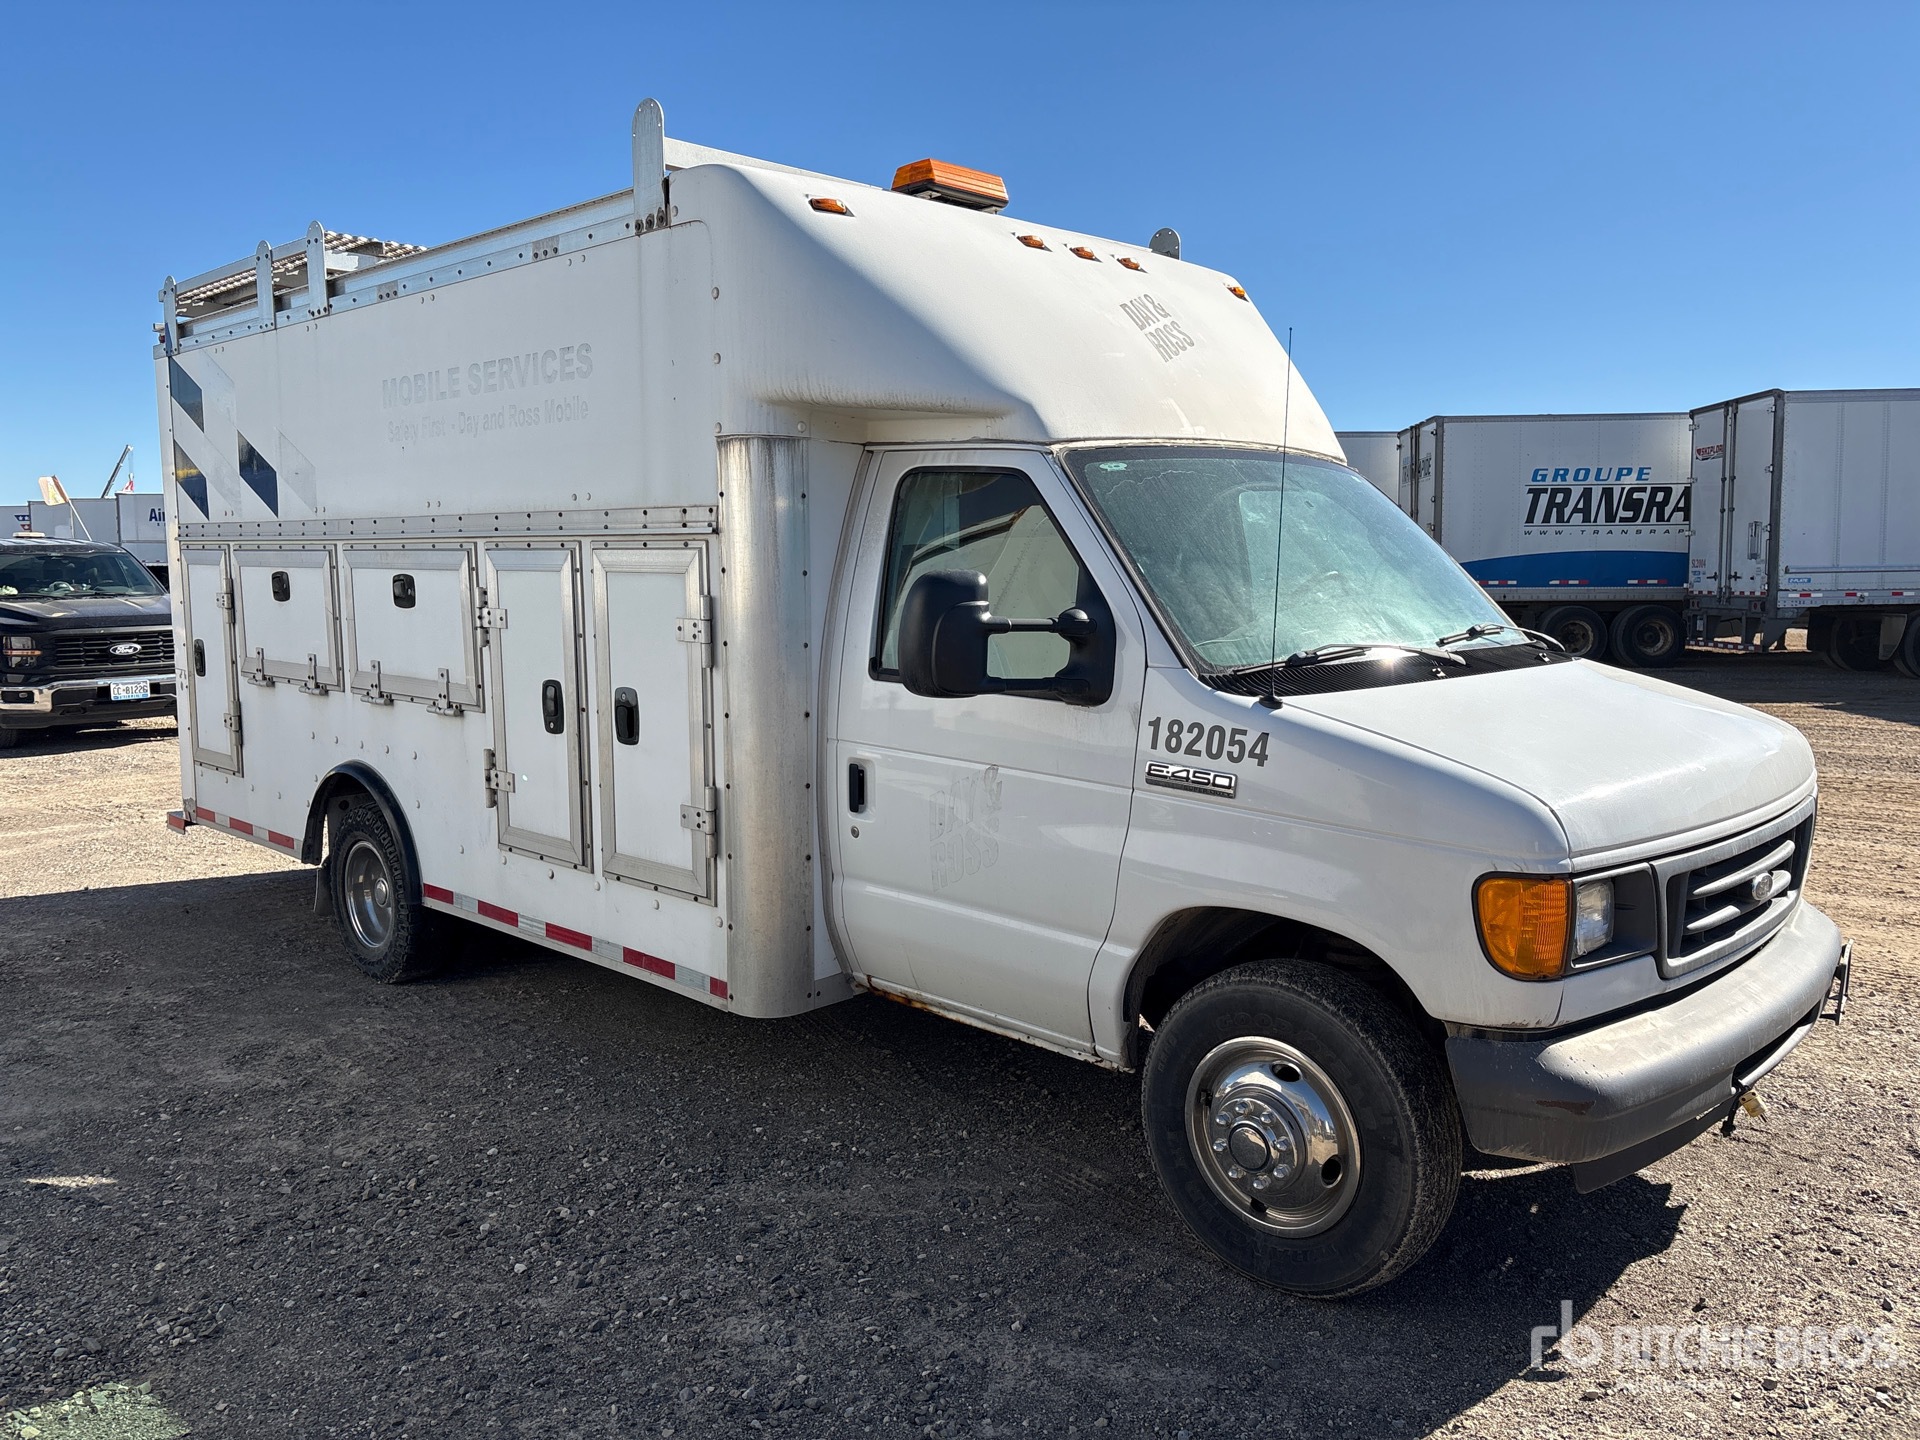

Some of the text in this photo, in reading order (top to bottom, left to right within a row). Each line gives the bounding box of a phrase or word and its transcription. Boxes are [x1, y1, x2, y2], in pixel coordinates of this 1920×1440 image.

[1144, 320, 1195, 363] ROSS
[382, 342, 594, 409] MOBILE SERVICES
[422, 415, 446, 439] First
[458, 411, 480, 439] Day
[483, 404, 505, 431] and
[509, 404, 541, 428] Ross
[544, 395, 590, 424] Mobile
[1531, 467, 1652, 482] GROUPE
[1524, 486, 1691, 525] TRANSRA
[1147, 716, 1270, 768] 182054
